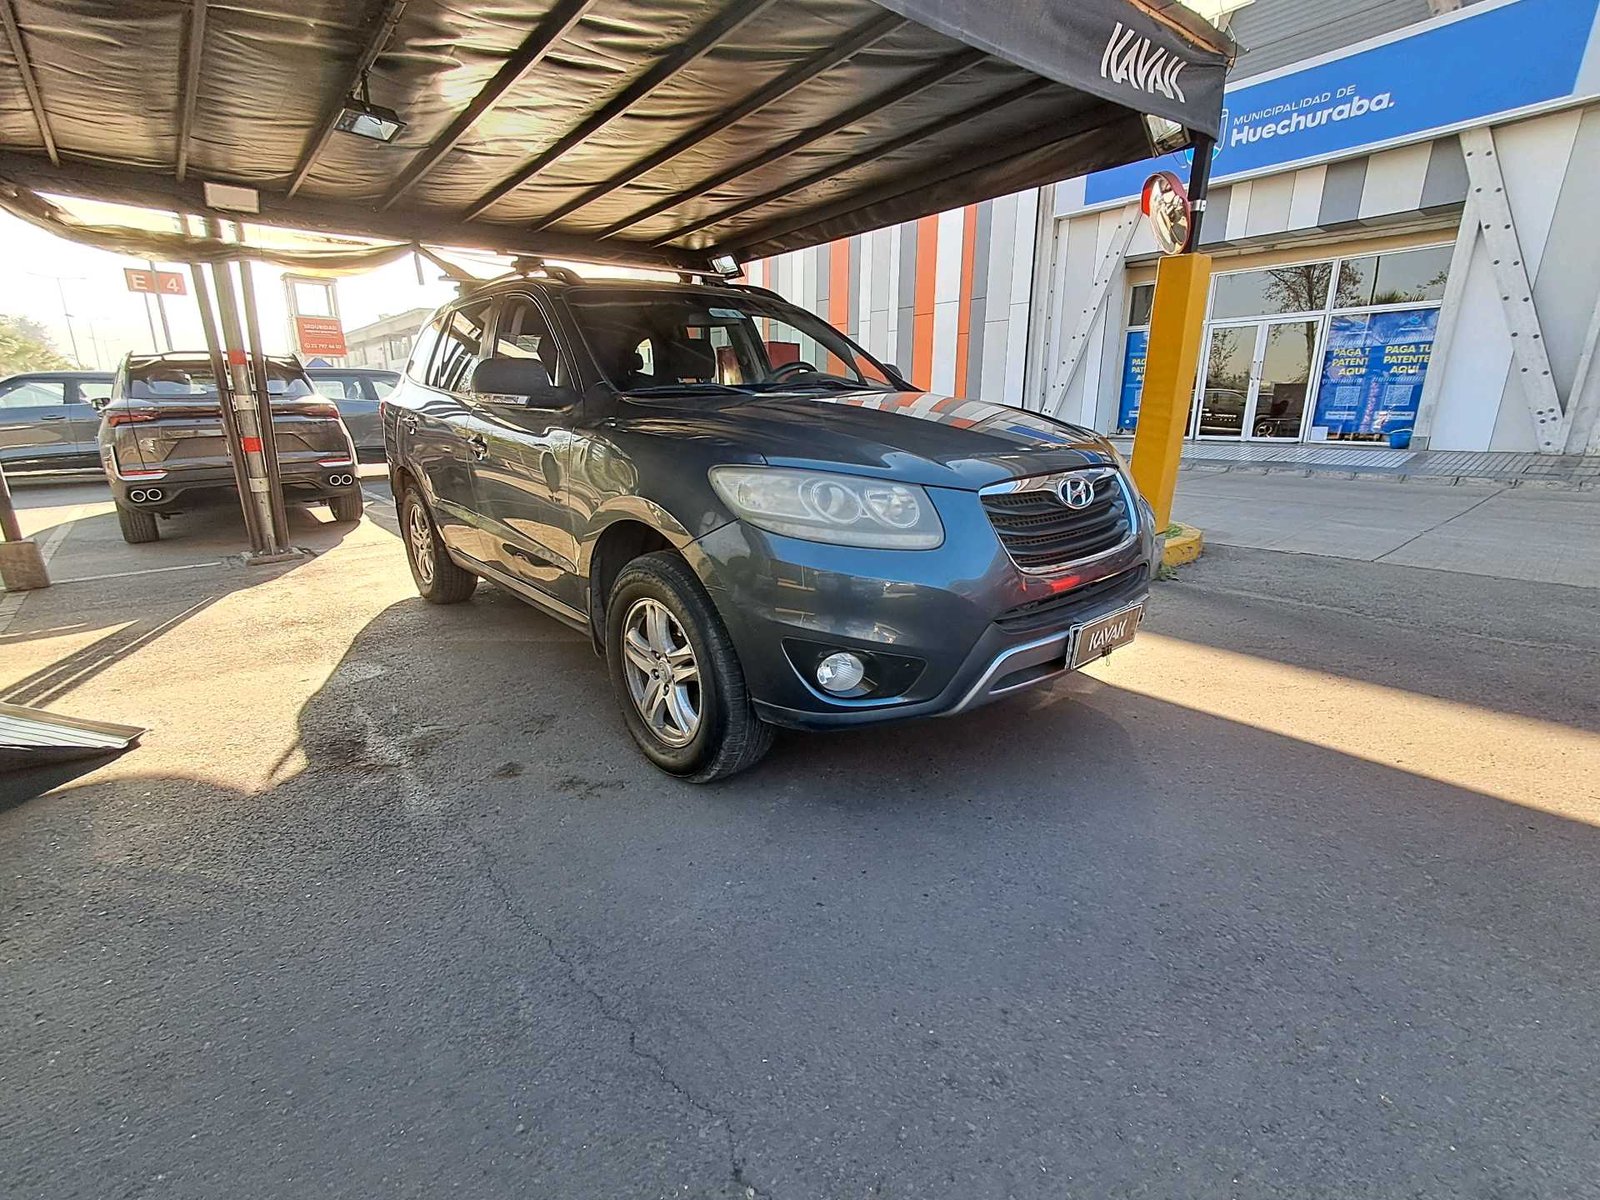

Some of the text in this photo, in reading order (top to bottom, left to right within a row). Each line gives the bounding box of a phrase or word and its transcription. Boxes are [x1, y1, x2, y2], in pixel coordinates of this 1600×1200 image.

[1101, 21, 1187, 103] KAVAK
[1233, 84, 1356, 126] MUNICIPALIDAD DE
[1230, 92, 1395, 148] Huechuraba.
[131, 274, 181, 292] E 4
[1333, 348, 1362, 357] PAGA
[1385, 344, 1431, 354] PAGA TU
[1332, 357, 1369, 367] PATENT
[1383, 354, 1431, 364] PATENTE
[1088, 619, 1127, 651] KAVAK
